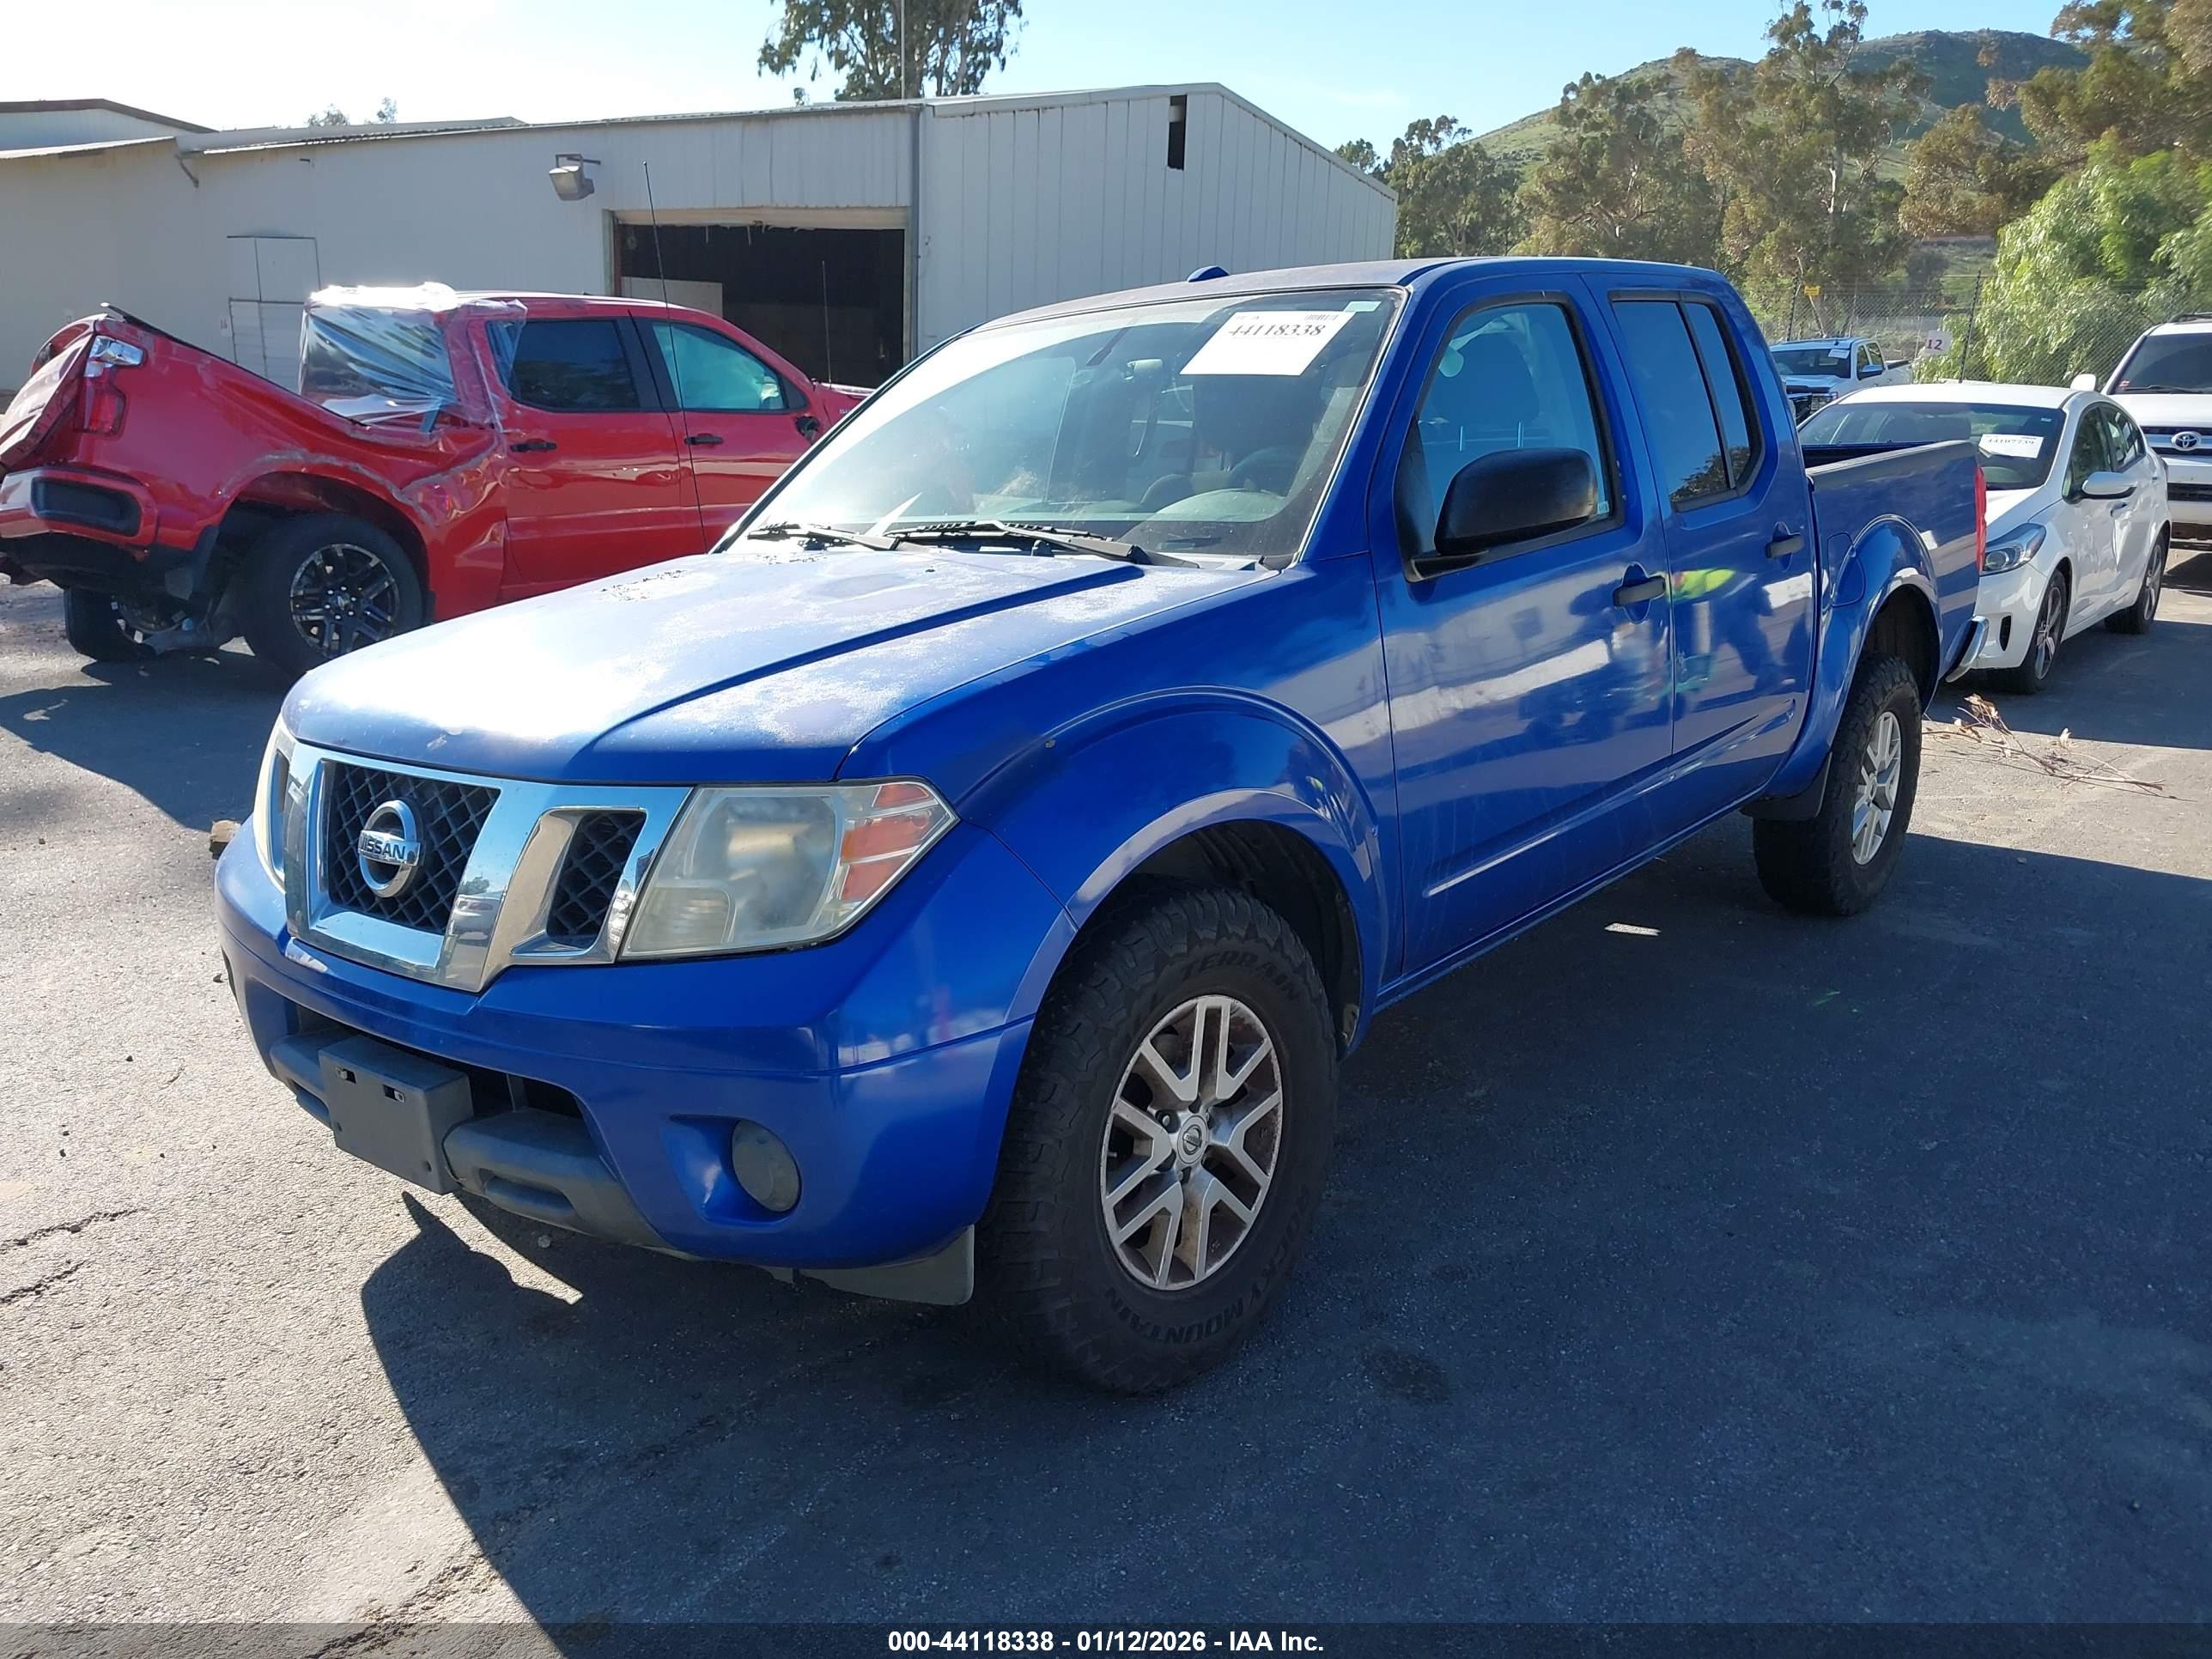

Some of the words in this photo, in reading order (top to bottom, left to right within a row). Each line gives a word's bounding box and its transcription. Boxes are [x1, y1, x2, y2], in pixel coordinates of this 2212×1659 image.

[1229, 324, 1326, 336] 44118338
[1927, 339, 1943, 350] 12
[359, 835, 406, 860] NISSAN
